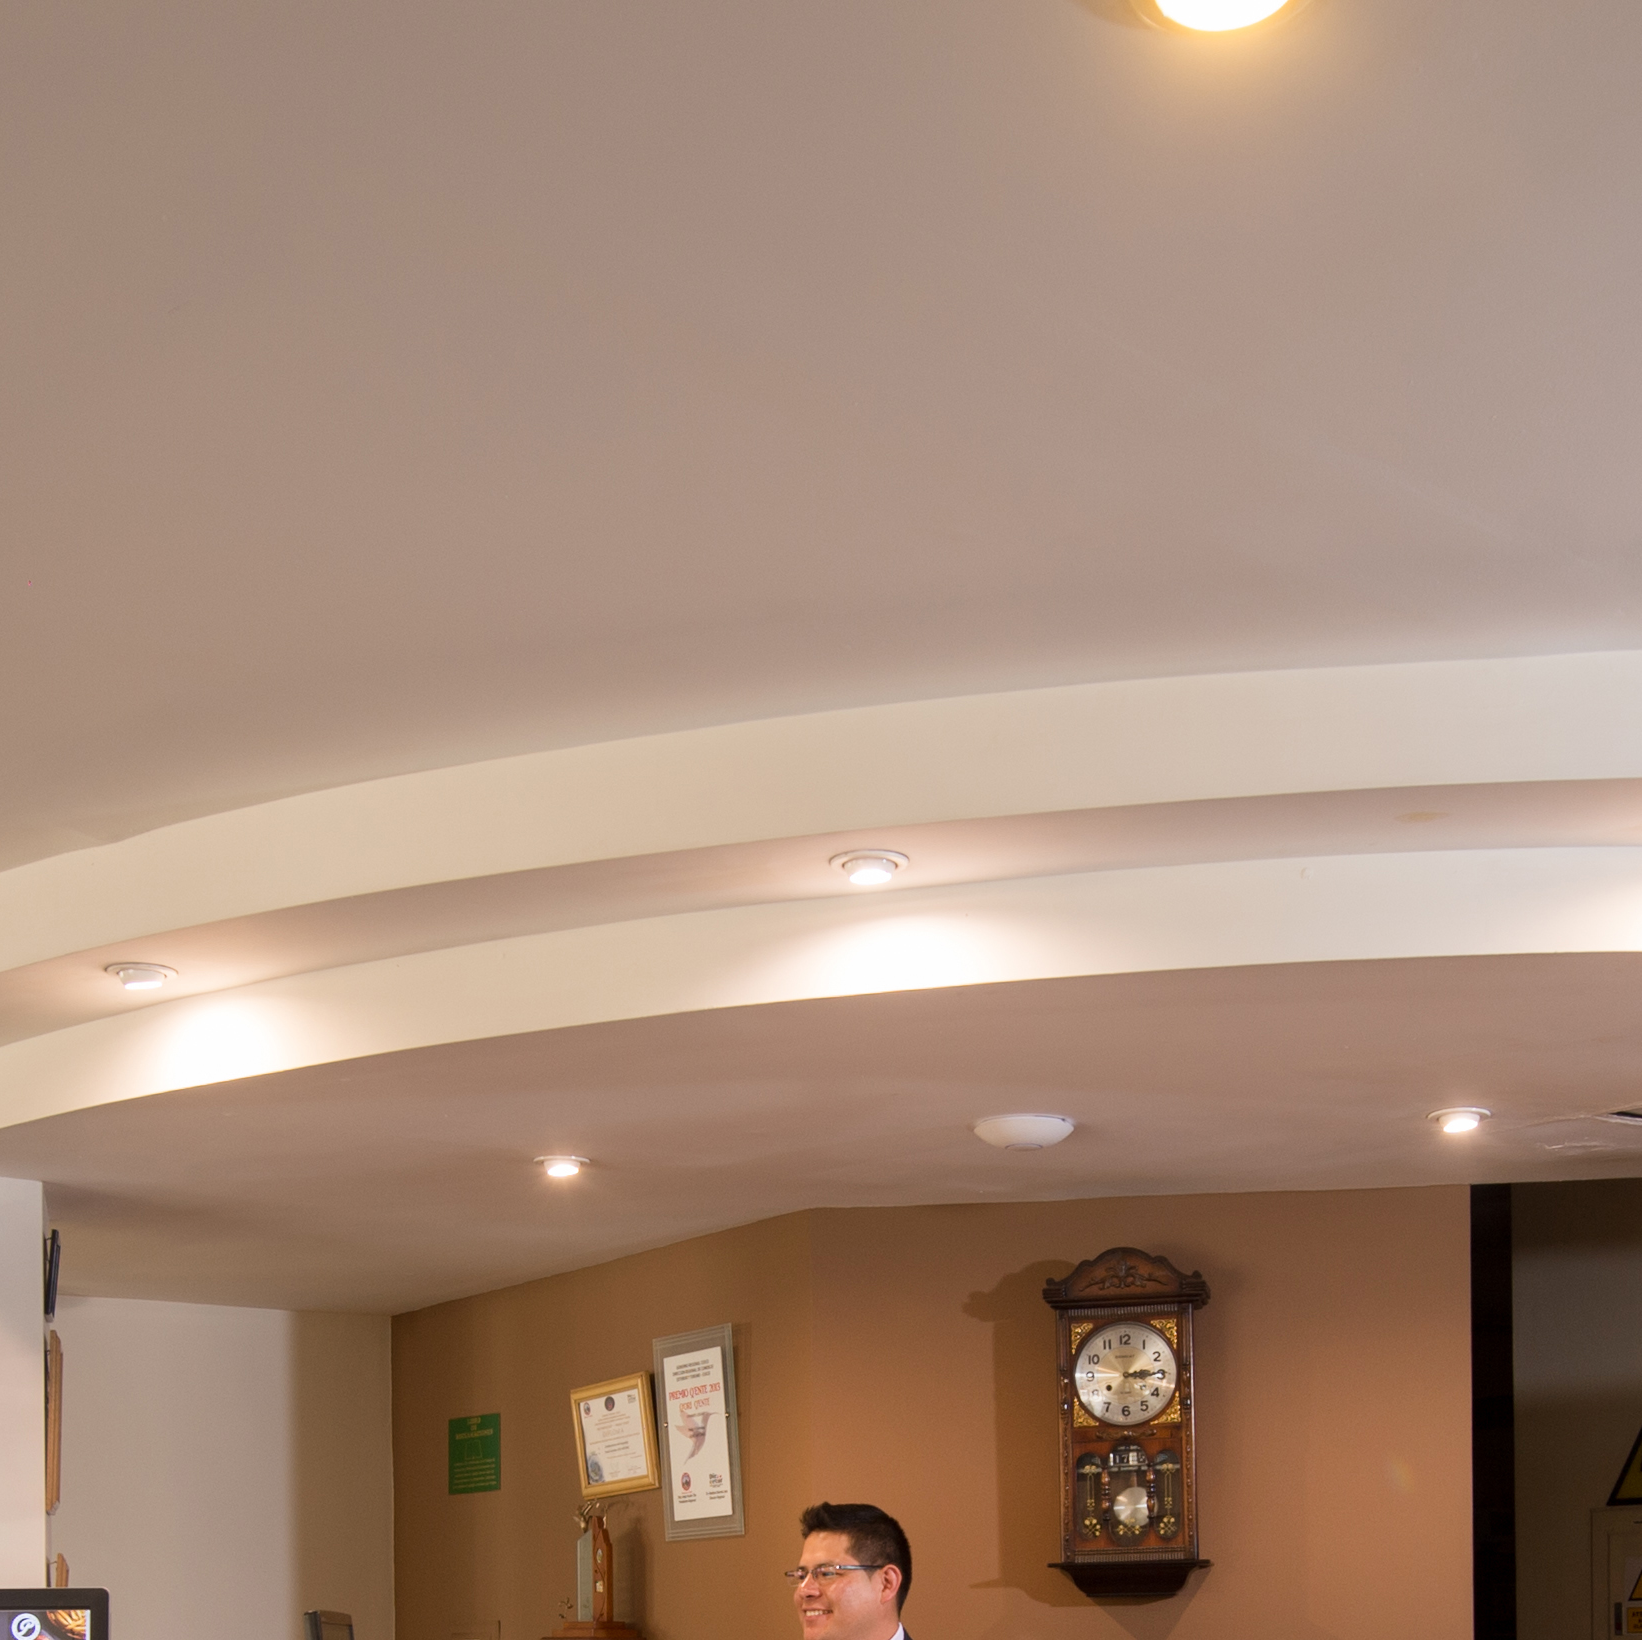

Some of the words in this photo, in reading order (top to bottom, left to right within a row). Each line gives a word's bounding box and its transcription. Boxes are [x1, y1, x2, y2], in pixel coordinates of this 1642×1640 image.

[1103, 1339, 1111, 1350] 11
[1119, 1334, 1131, 1346] 12
[1142, 1339, 1146, 1350] 1
[1088, 1354, 1100, 1365] 10
[1152, 1351, 1161, 1362] 2
[1086, 1371, 1095, 1382] 9
[1157, 1369, 1166, 1380] 3
[669, 1389, 689, 1401] PREMIO
[709, 1382, 720, 1393] 2013
[1150, 1387, 1160, 1397] 4
[1103, 1402, 1111, 1412] 7
[1121, 1406, 1131, 1416] 6
[1140, 1401, 1149, 1412] 5
